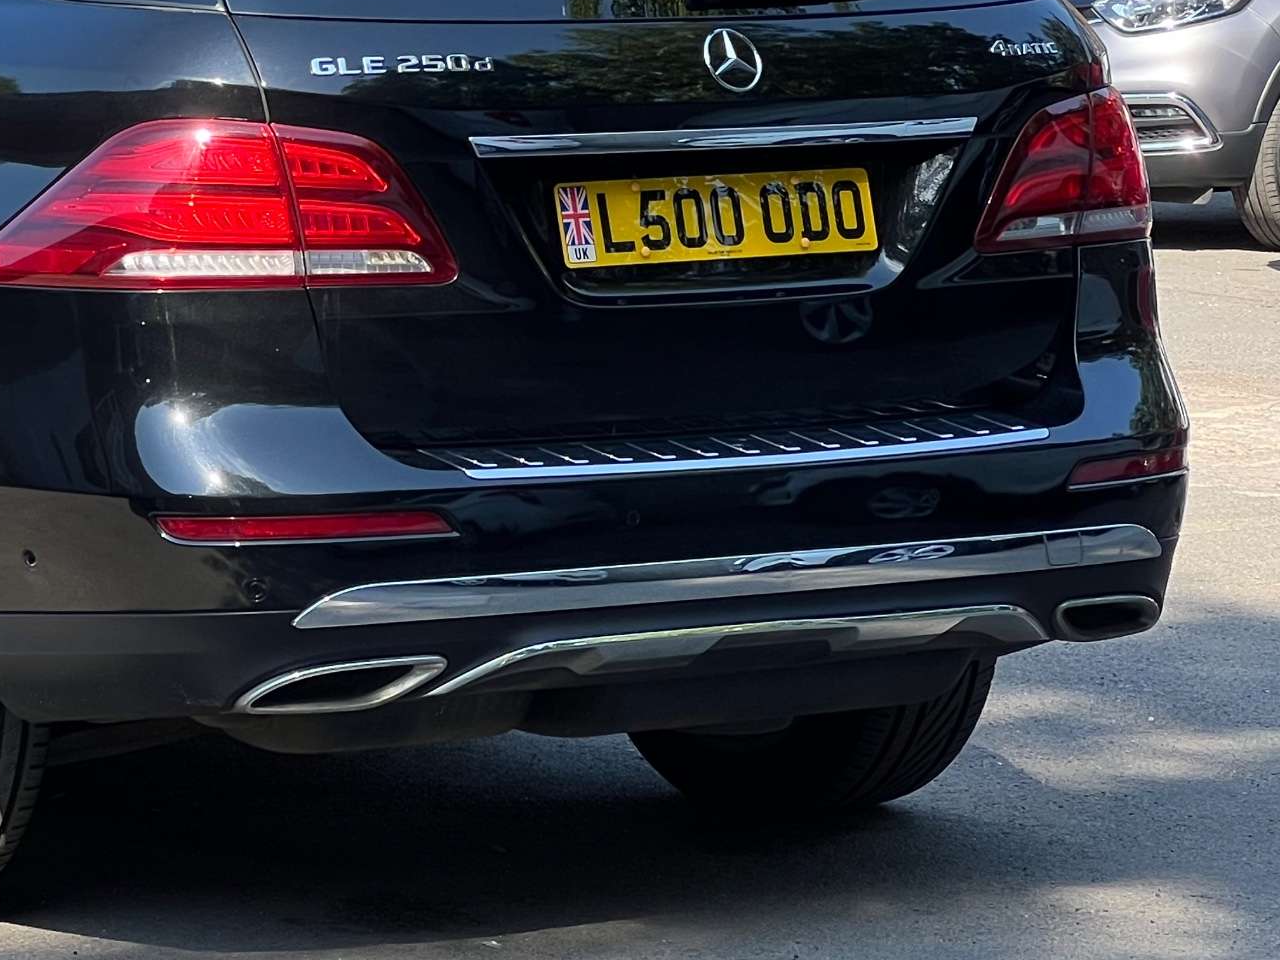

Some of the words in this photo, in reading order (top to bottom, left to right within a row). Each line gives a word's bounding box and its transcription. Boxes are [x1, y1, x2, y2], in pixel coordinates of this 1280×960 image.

[988, 39, 1058, 57] 4MATIC
[310, 56, 387, 76] GLE
[396, 53, 495, 74] 250d
[596, 184, 745, 254] L500
[573, 246, 592, 262] UK
